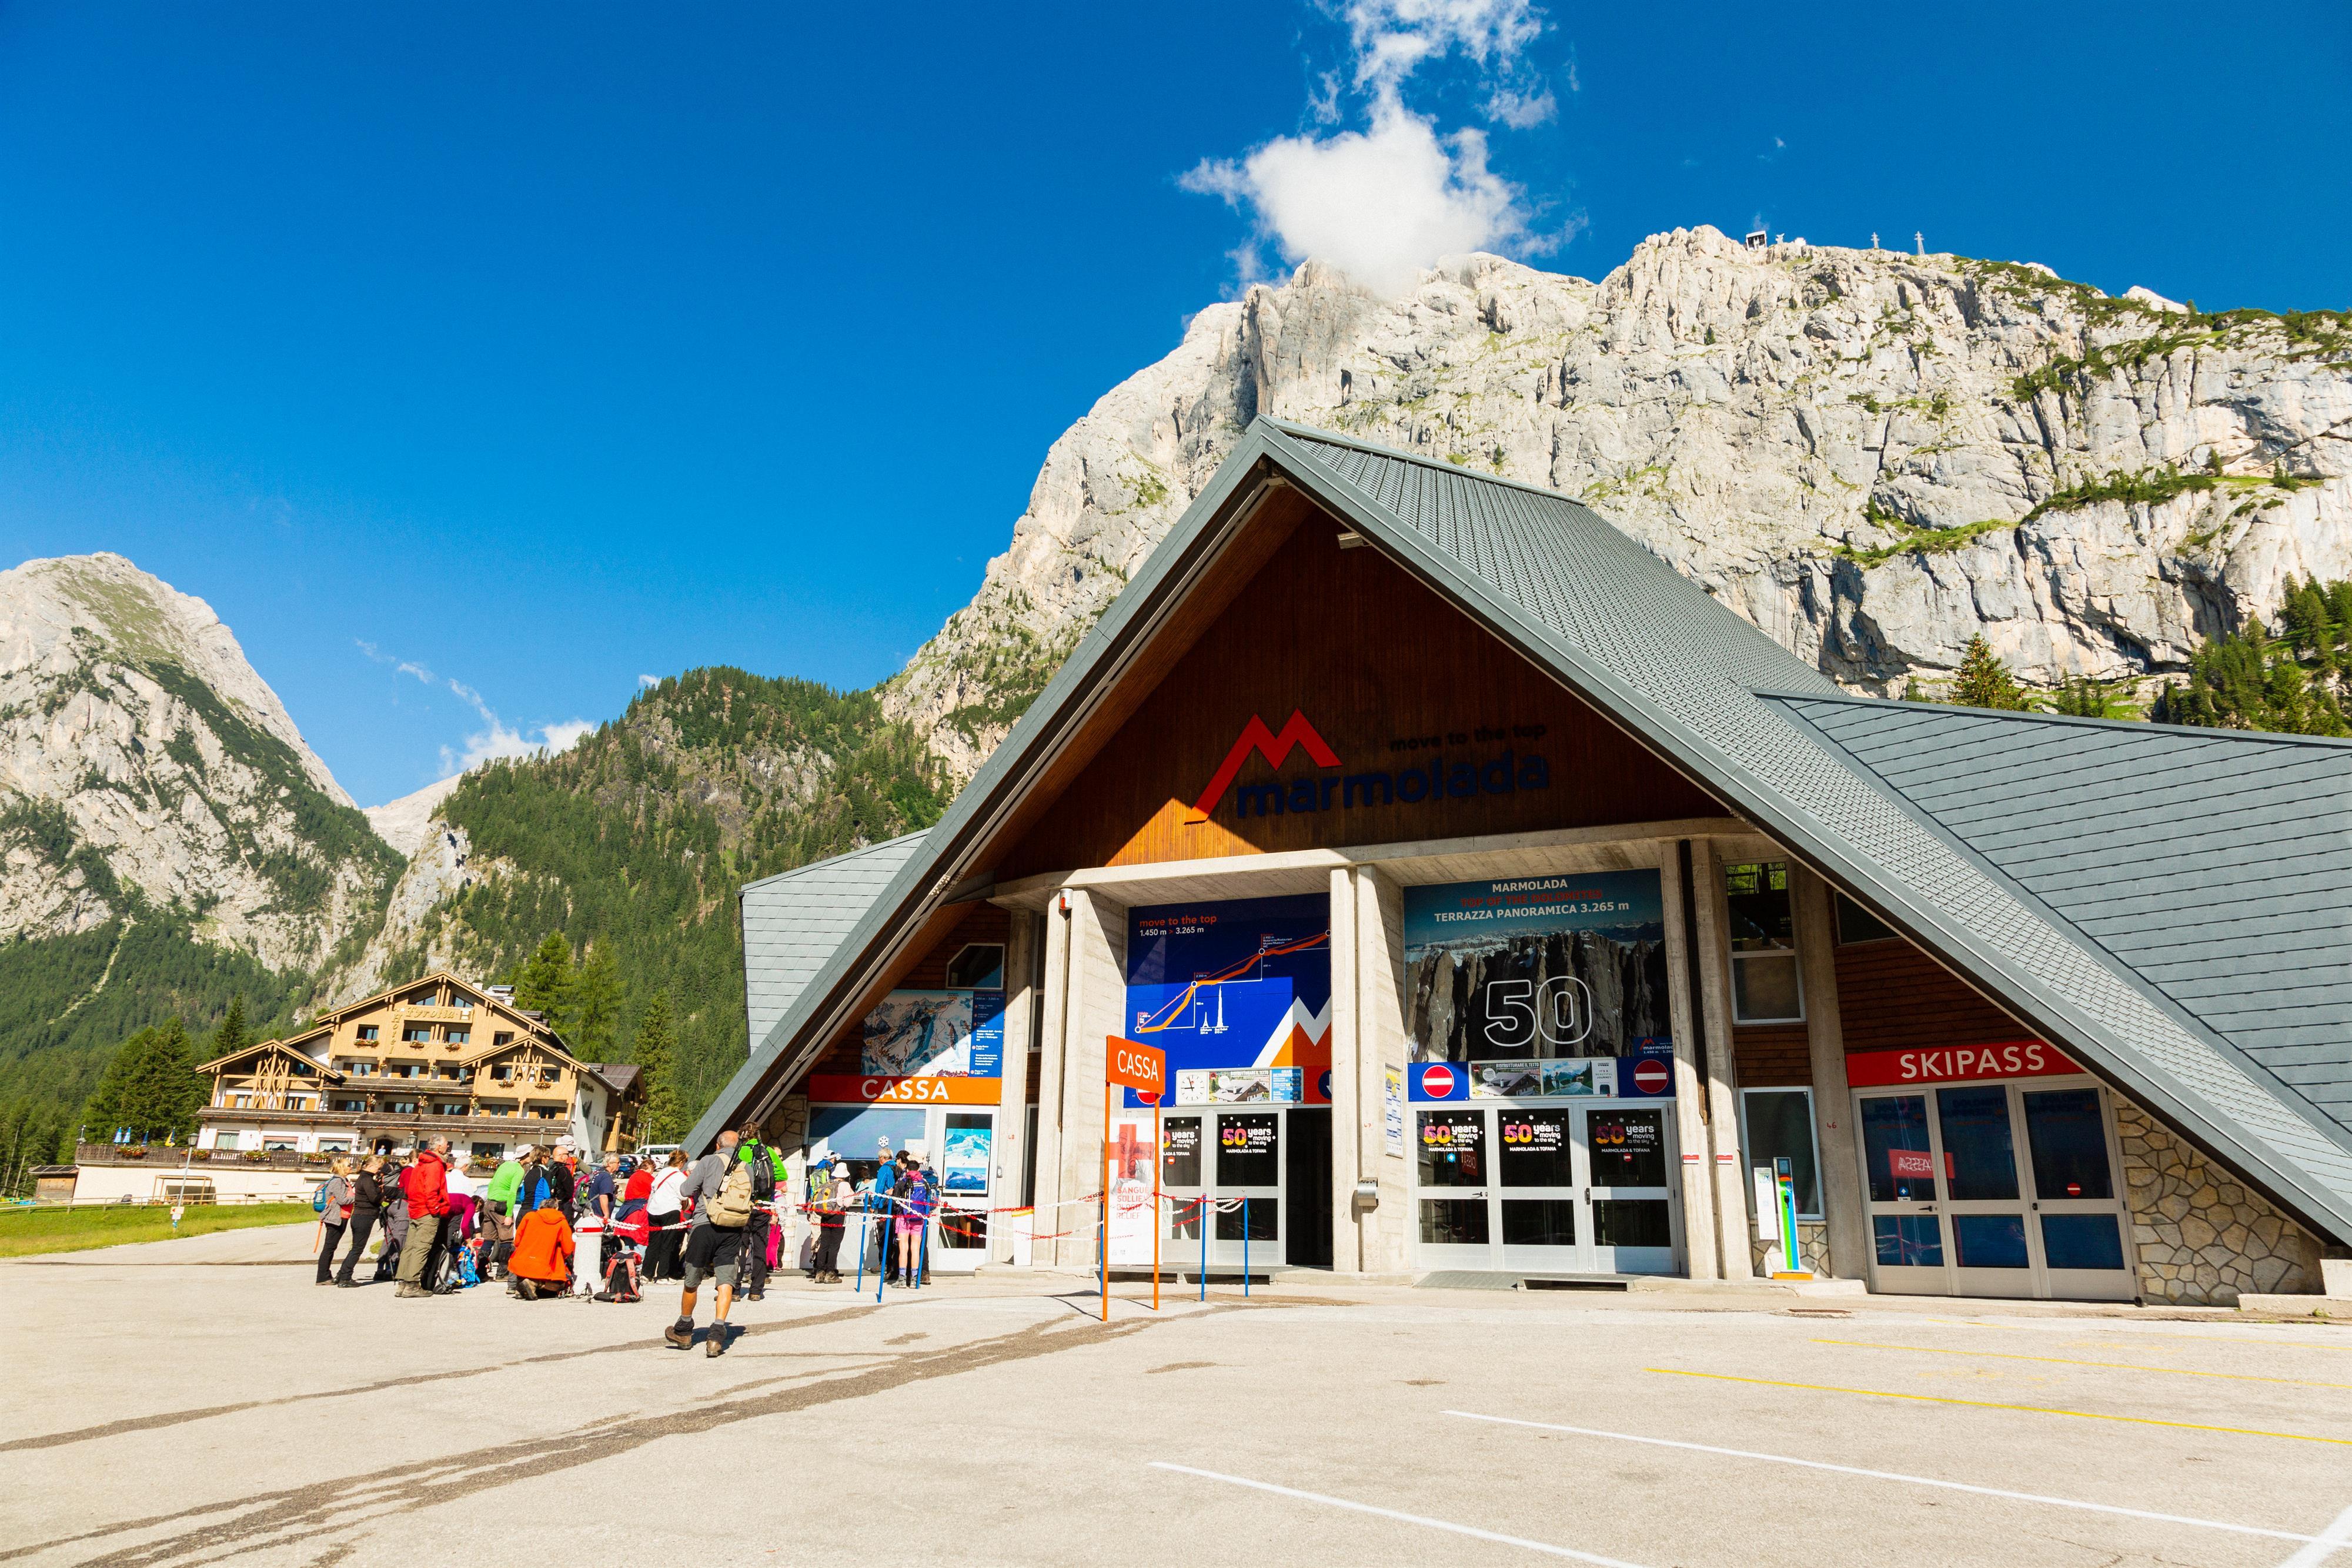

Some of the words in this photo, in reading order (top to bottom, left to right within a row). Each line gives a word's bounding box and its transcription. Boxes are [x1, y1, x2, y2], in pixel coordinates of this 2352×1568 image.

[1390, 733, 1441, 751] move
[1447, 730, 1468, 745] to
[1475, 724, 1504, 743] the
[1513, 722, 1546, 741] top
[1238, 748, 1549, 819] marmolada
[1492, 879, 1568, 893] MARMOLADA
[1461, 897, 1482, 908] TOP
[1486, 896, 1501, 905] OF
[1505, 894, 1528, 905] THE
[1531, 889, 1602, 904] DOLOMITES
[1140, 917, 1165, 927] move
[1168, 917, 1178, 925] to
[1181, 915, 1197, 924] the
[1200, 915, 1217, 924] top
[1434, 910, 1492, 922] TERRAZZA
[1497, 904, 1577, 919] PANORAMICA
[1581, 902, 1613, 913] 3.265
[1618, 902, 1629, 911] m
[1484, 976, 1592, 1047] 50
[1117, 1049, 1158, 1082] CASSA
[1900, 1045, 2044, 1079] SKIPASS
[861, 1079, 949, 1100] CASSA
[1164, 1131, 1171, 1148] 0
[1172, 1131, 1195, 1141] years
[1222, 1128, 1247, 1146] 50
[1248, 1128, 1271, 1138] years
[1424, 1125, 1451, 1144] 50
[1451, 1125, 1478, 1135] years
[1504, 1124, 1532, 1143] 50
[1534, 1124, 1561, 1135] years
[1539, 1132, 1561, 1141] moving
[1595, 1126, 1625, 1144] 50
[1626, 1125, 1654, 1135] years
[1633, 1133, 1655, 1141] moving
